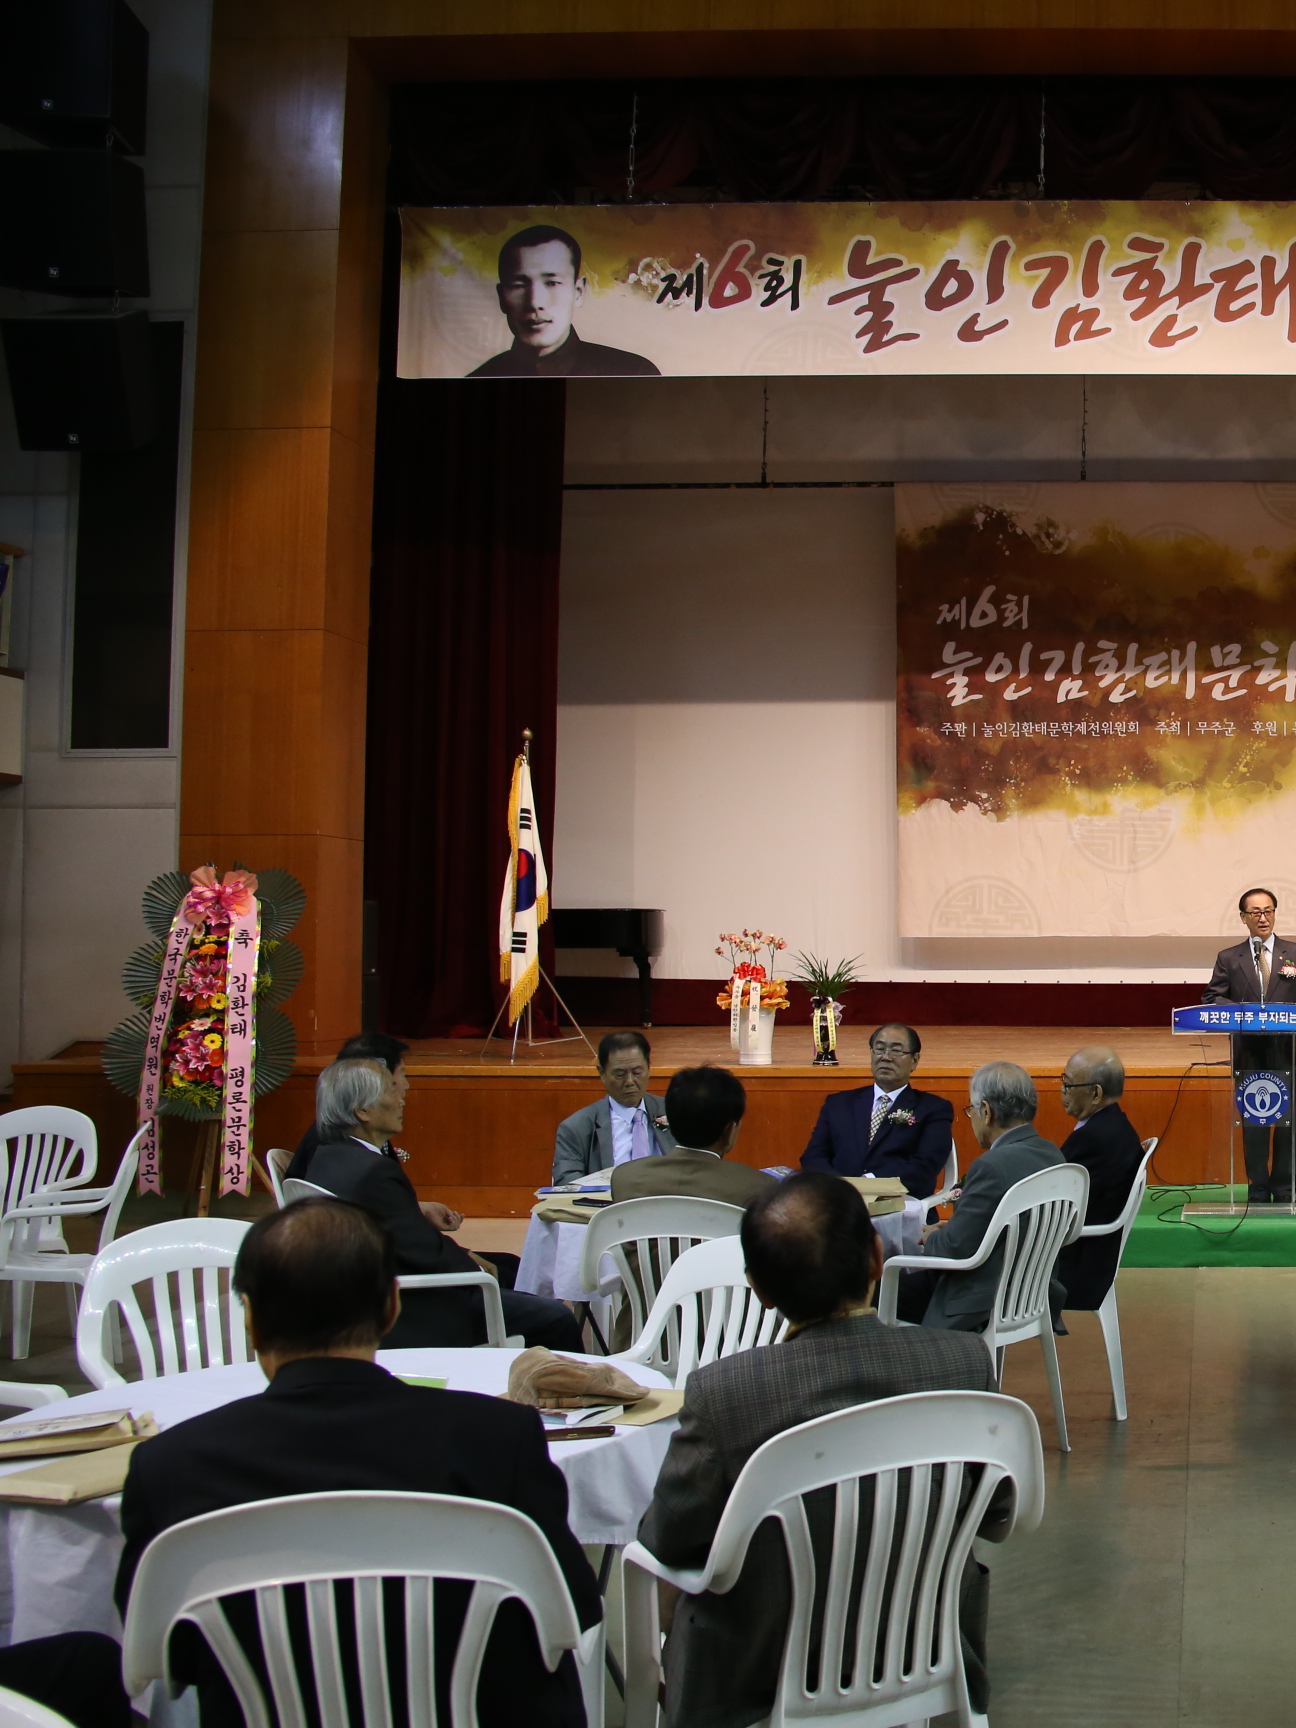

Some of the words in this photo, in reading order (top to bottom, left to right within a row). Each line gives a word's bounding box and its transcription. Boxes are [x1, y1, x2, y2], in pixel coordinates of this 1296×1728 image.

[656, 243, 801, 312] 제6회
[936, 585, 1029, 630] 제6회
[940, 722, 967, 738] 주관
[1155, 721, 1181, 738] 주최
[1196, 721, 1236, 738] 무주군
[1250, 721, 1278, 737] 후원
[234, 930, 253, 948] 축
[230, 973, 250, 1040] 김환태
[1199, 1011, 1230, 1024] 깨끗한
[1260, 1072, 1287, 1091] COUNTY
[224, 1066, 248, 1186] 평론문학상
